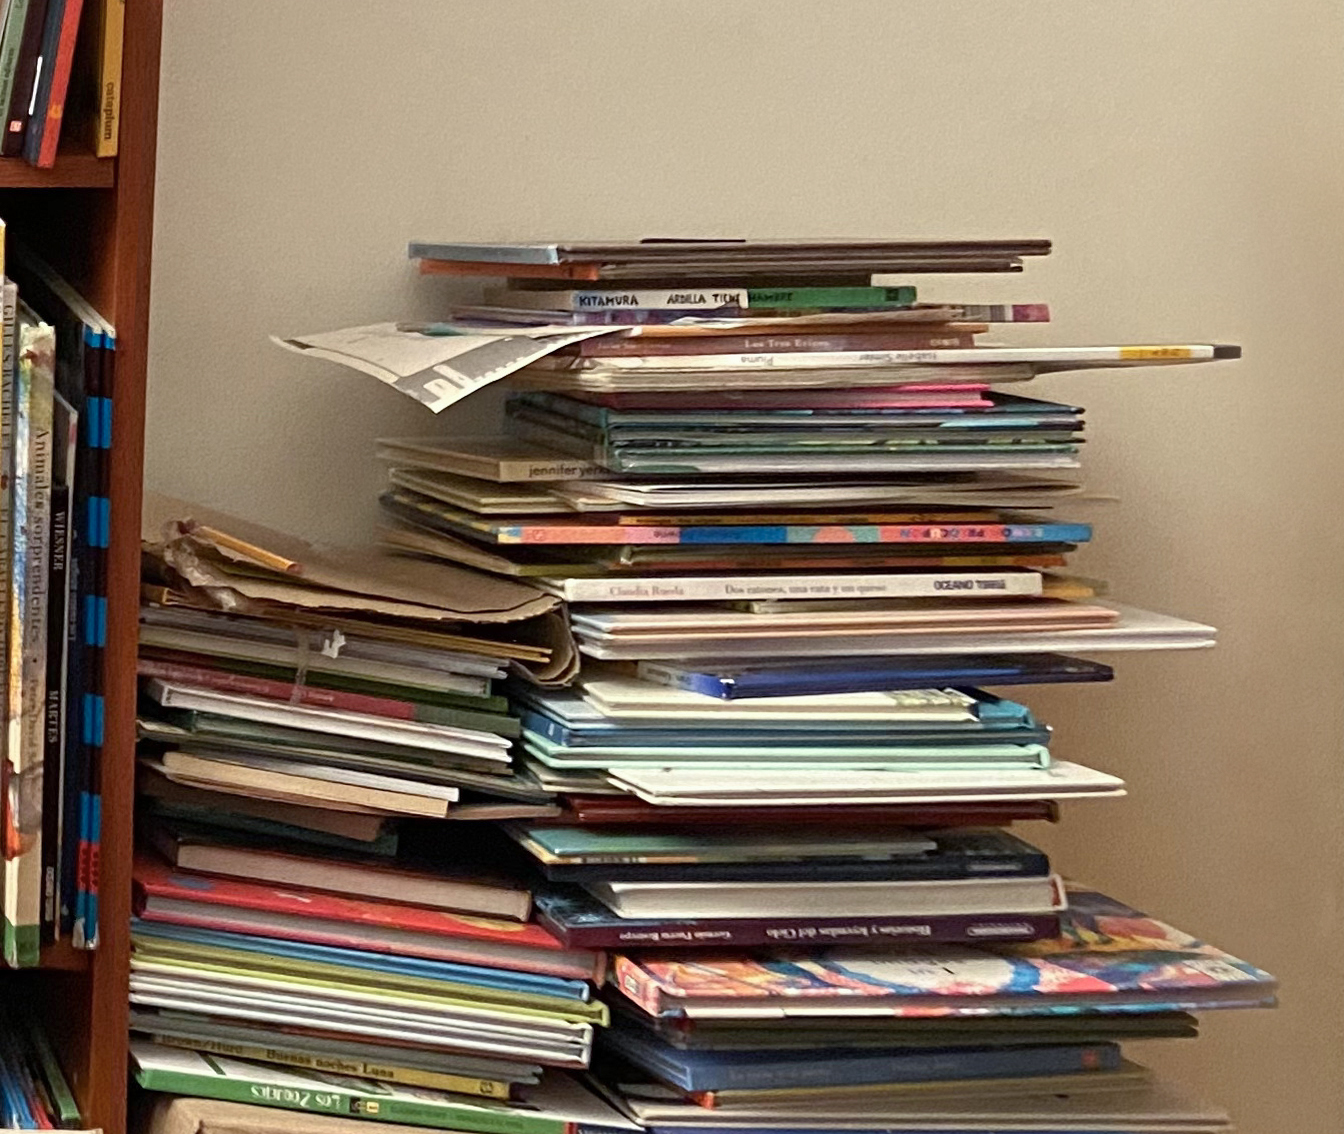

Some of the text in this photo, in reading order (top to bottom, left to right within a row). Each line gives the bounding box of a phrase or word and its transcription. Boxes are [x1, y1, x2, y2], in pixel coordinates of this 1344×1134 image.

[100, 81, 117, 140] cataplum
[577, 291, 706, 307] KITAMURA ARDILLA
[528, 463, 575, 478] jennifer
[26, 426, 50, 643] Animales sorprendentes
[46, 510, 66, 743] WIESNER MARTES
